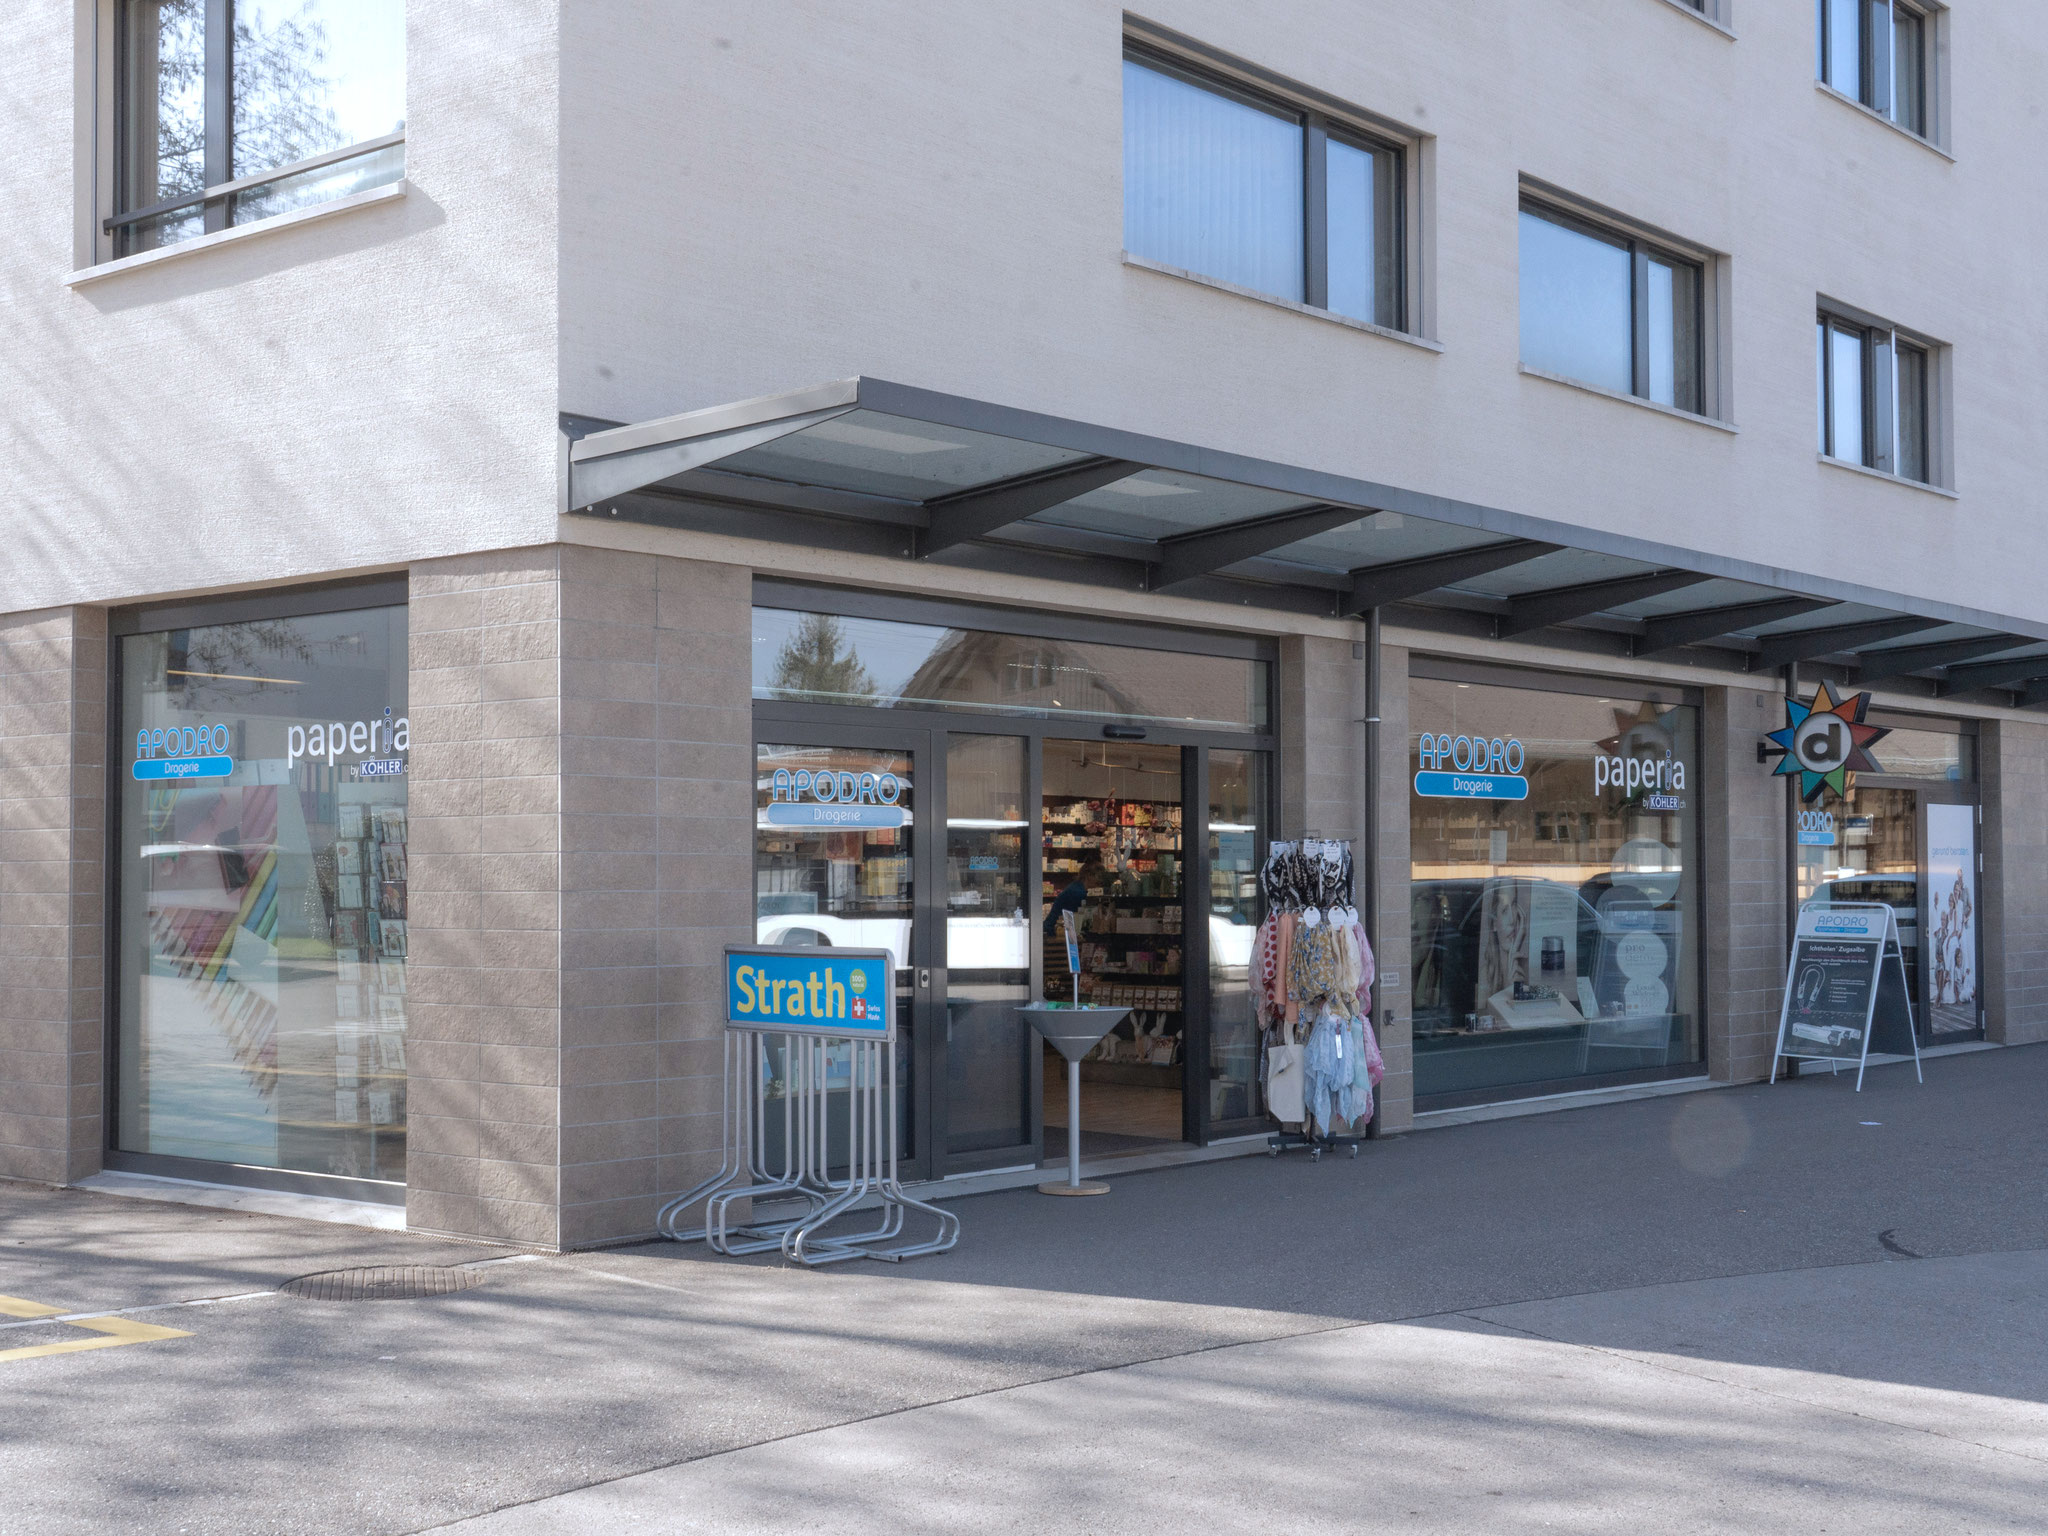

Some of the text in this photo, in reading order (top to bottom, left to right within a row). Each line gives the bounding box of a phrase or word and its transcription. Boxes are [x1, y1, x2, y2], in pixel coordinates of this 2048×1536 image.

[137, 723, 230, 758] APODRO
[288, 706, 409, 769] paperia
[1801, 723, 1841, 761] d
[1419, 732, 1525, 774] APODRO
[164, 762, 199, 776] Drogerie
[350, 765, 359, 777] by
[1594, 748, 1685, 797] paperia
[772, 768, 900, 804] APODRO
[1453, 777, 1493, 795] Drogerie
[1642, 798, 1649, 809] by
[813, 808, 861, 824] Drogerie
[1817, 915, 1868, 926] APODRO
[736, 965, 846, 1019] Strath
[867, 1004, 880, 1012] Swiss
[867, 1013, 880, 1021] Made
